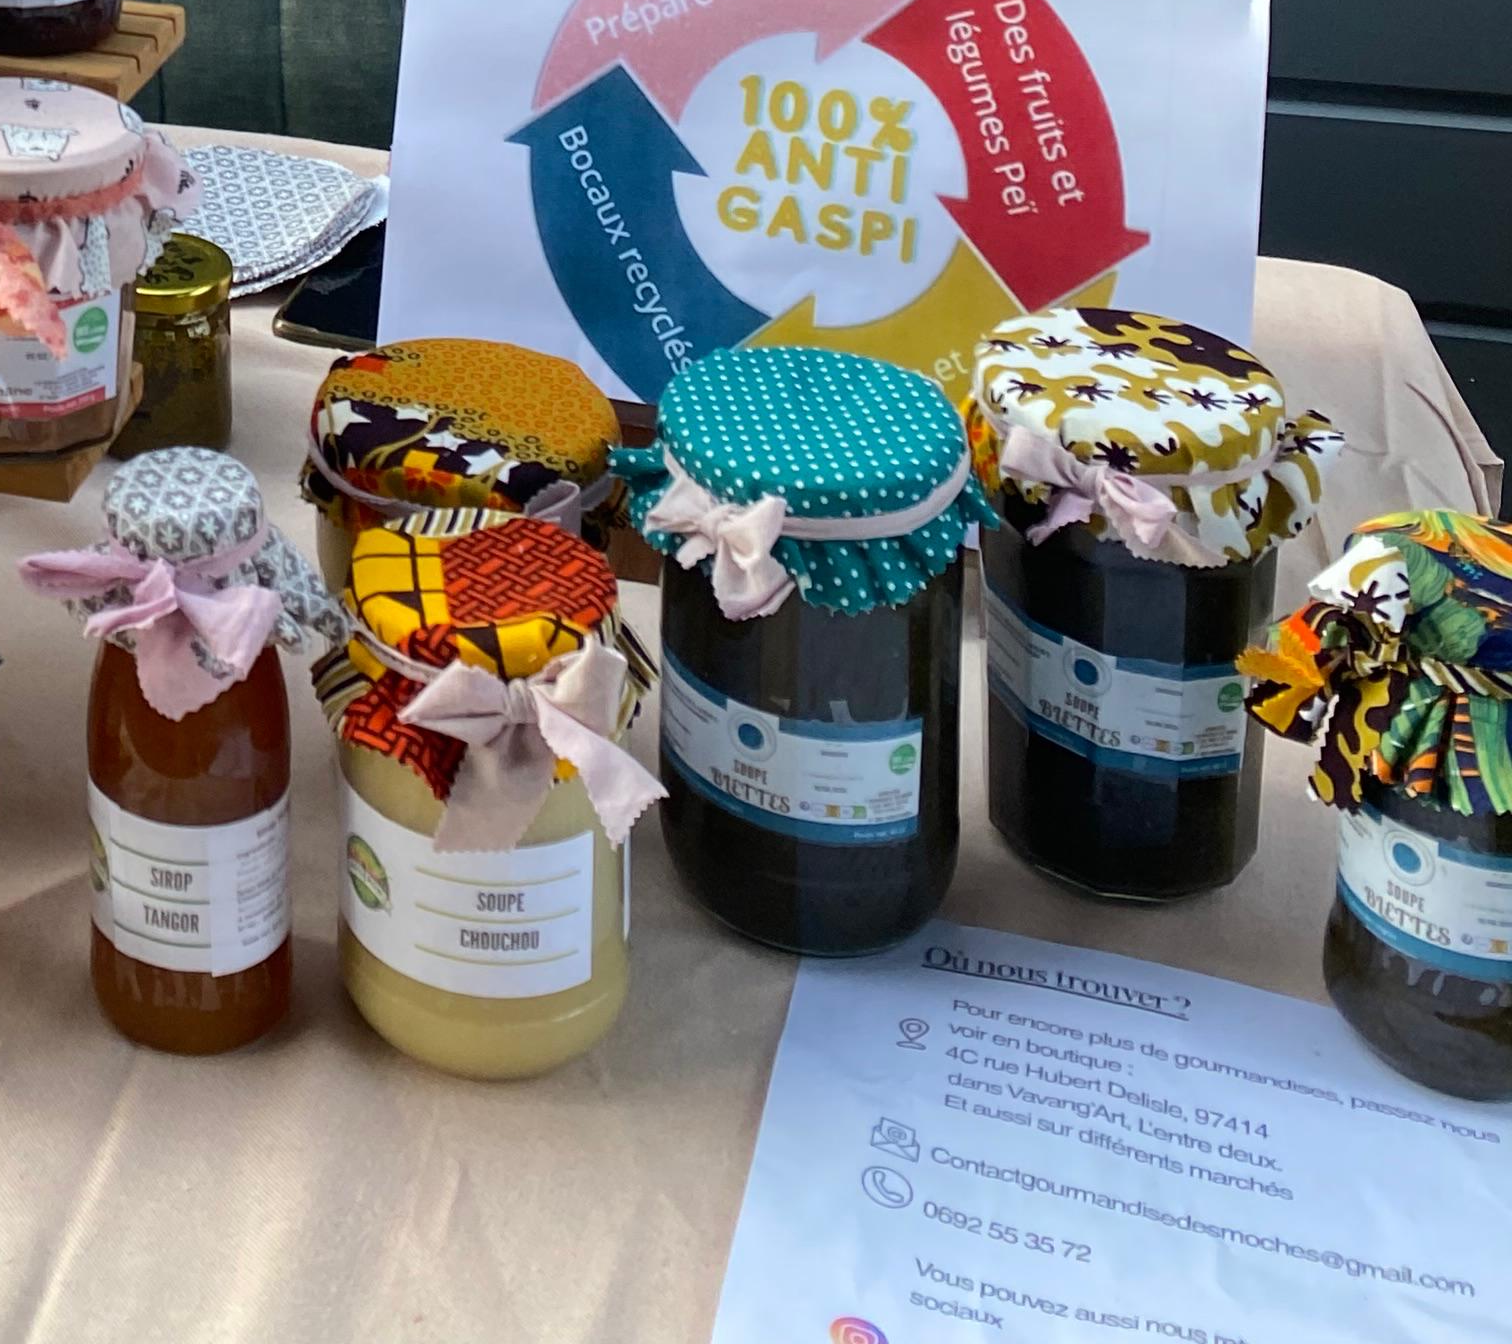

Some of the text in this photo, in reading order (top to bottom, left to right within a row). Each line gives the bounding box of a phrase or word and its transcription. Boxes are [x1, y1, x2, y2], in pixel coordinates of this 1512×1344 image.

[738, 73, 916, 154] 100%
[944, 9, 1011, 156] légumes
[733, 128, 909, 205] ANTI
[1017, 68, 1069, 163] fruits
[1050, 168, 1086, 208] et
[557, 124, 632, 246] Bocaux
[715, 184, 918, 265] GASPI
[1065, 691, 1100, 720] SOUPE
[733, 758, 768, 786] SOUPE
[149, 866, 194, 893] SIROP
[476, 891, 526, 913] SOUPE
[1387, 880, 1426, 914] SOUPE
[142, 902, 200, 935] TANGOR
[459, 928, 540, 952] CHOUCHOU
[922, 945, 970, 973] Où
[977, 958, 1049, 985] nous
[1054, 969, 1170, 1010] trouver
[948, 1022, 989, 1042] voir
[991, 1032, 1021, 1050] en
[1025, 1038, 1123, 1074] boutique
[952, 998, 1502, 1145] Pour encore plus de gourmandises, passez nous
[945, 1045, 1270, 1140] 4C rue Hubert Delisle, 97414
[947, 1072, 1004, 1097] dans
[1138, 1116, 1214, 1155] L'entre
[1217, 1142, 1284, 1173] deux.
[943, 1093, 1295, 1201] Et aussi sur différents marchés
[922, 1199, 1093, 1264] 0692 55 35 72
[909, 1290, 1004, 1330] sociaux
[913, 1256, 1209, 1344] Vous pouvez aussi nous
